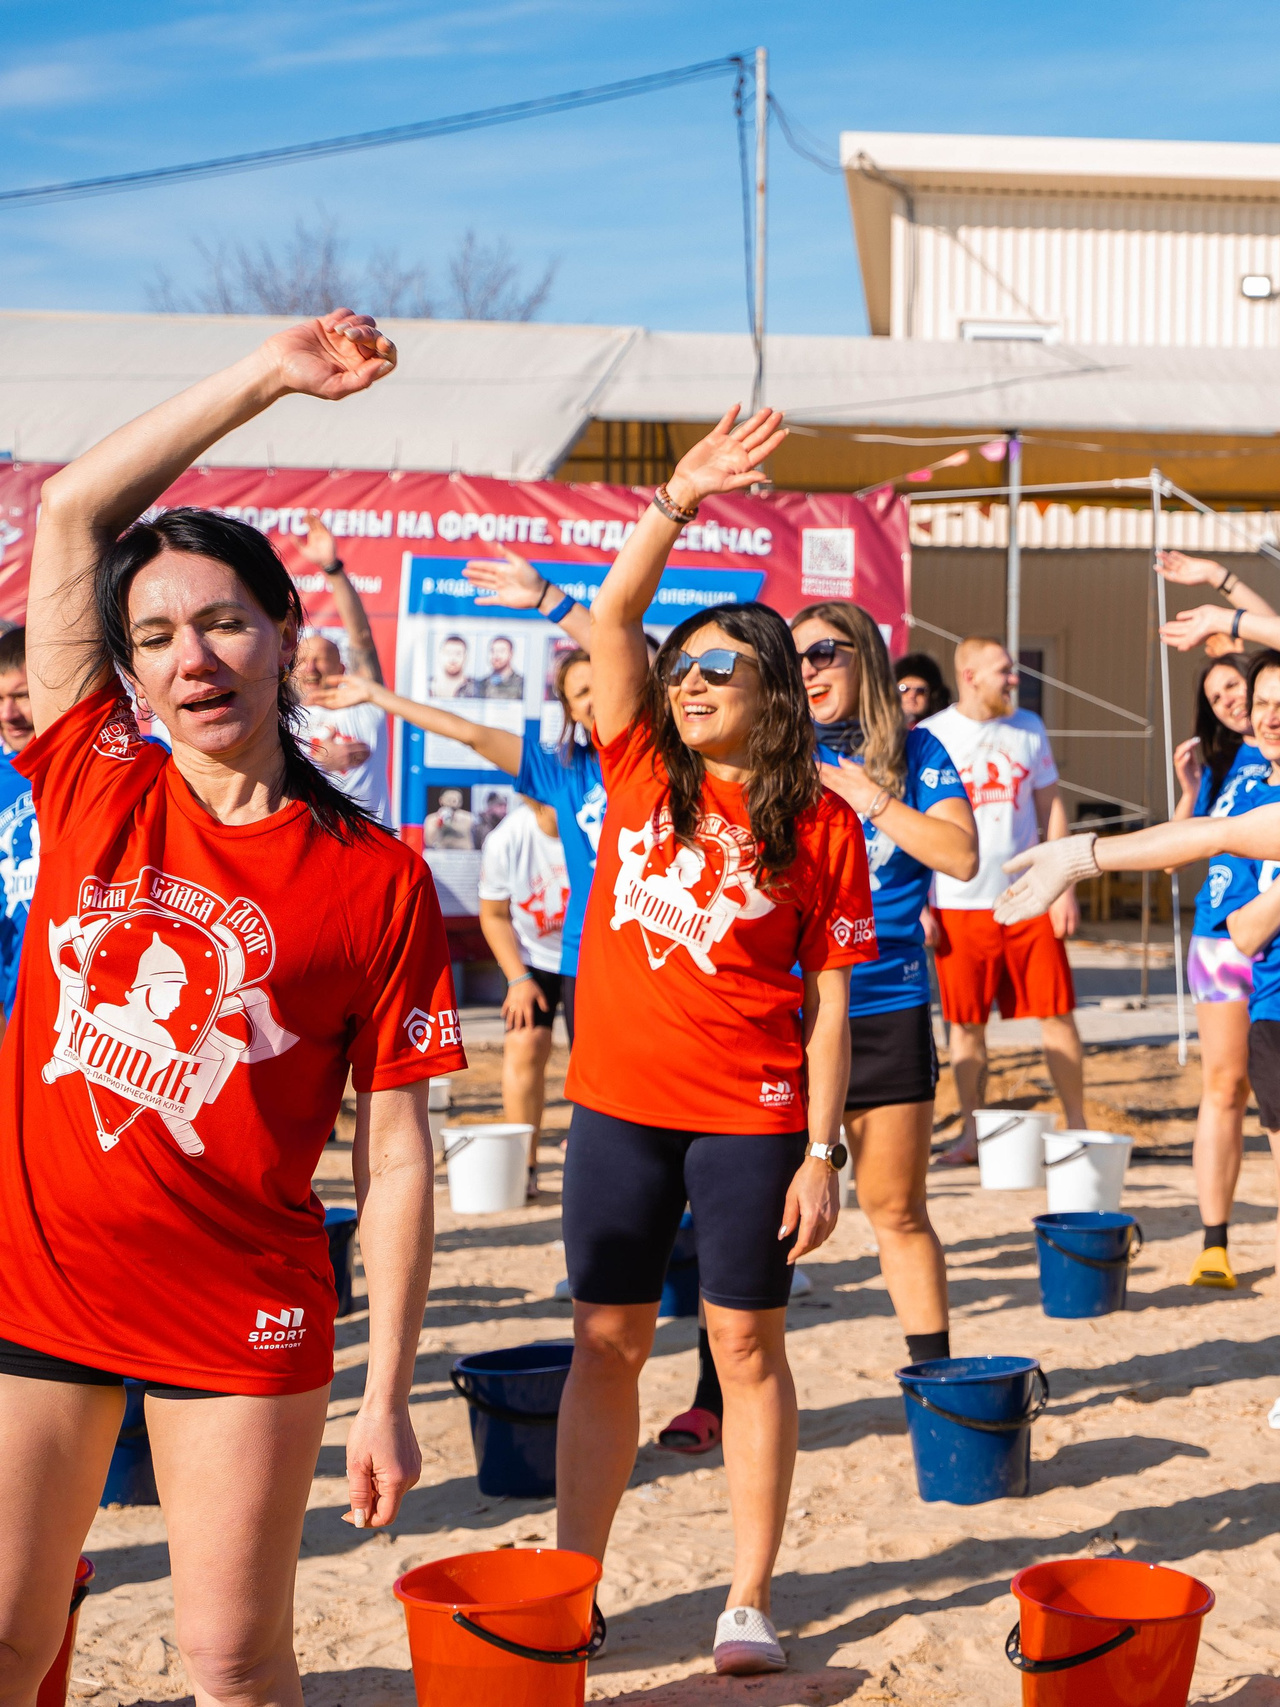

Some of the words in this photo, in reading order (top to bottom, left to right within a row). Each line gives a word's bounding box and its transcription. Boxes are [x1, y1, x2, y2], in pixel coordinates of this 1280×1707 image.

[207, 505, 393, 538] ОРТСЕНЫ
[396, 510, 435, 539] НА
[437, 510, 554, 546] ФРОНТЕ.
[672, 520, 773, 556] СЕЙЧАС
[82, 884, 127, 910] СИЛА
[149, 877, 216, 924] СЛАВА
[226, 901, 268, 956] ДОЛГ
[438, 1009, 459, 1027] ПУ
[440, 1026, 462, 1048] ДО
[68, 1009, 202, 1104] ЯРОПОЛК
[63, 1049, 162, 1106] СПОРНО-ПАТРИОТИЧЕСКИЙ
[162, 1099, 186, 1115] КЛУБ
[758, 1092, 796, 1103] SPORT
[247, 1328, 307, 1343] SPORT
[253, 1342, 302, 1350] LABORATORY
